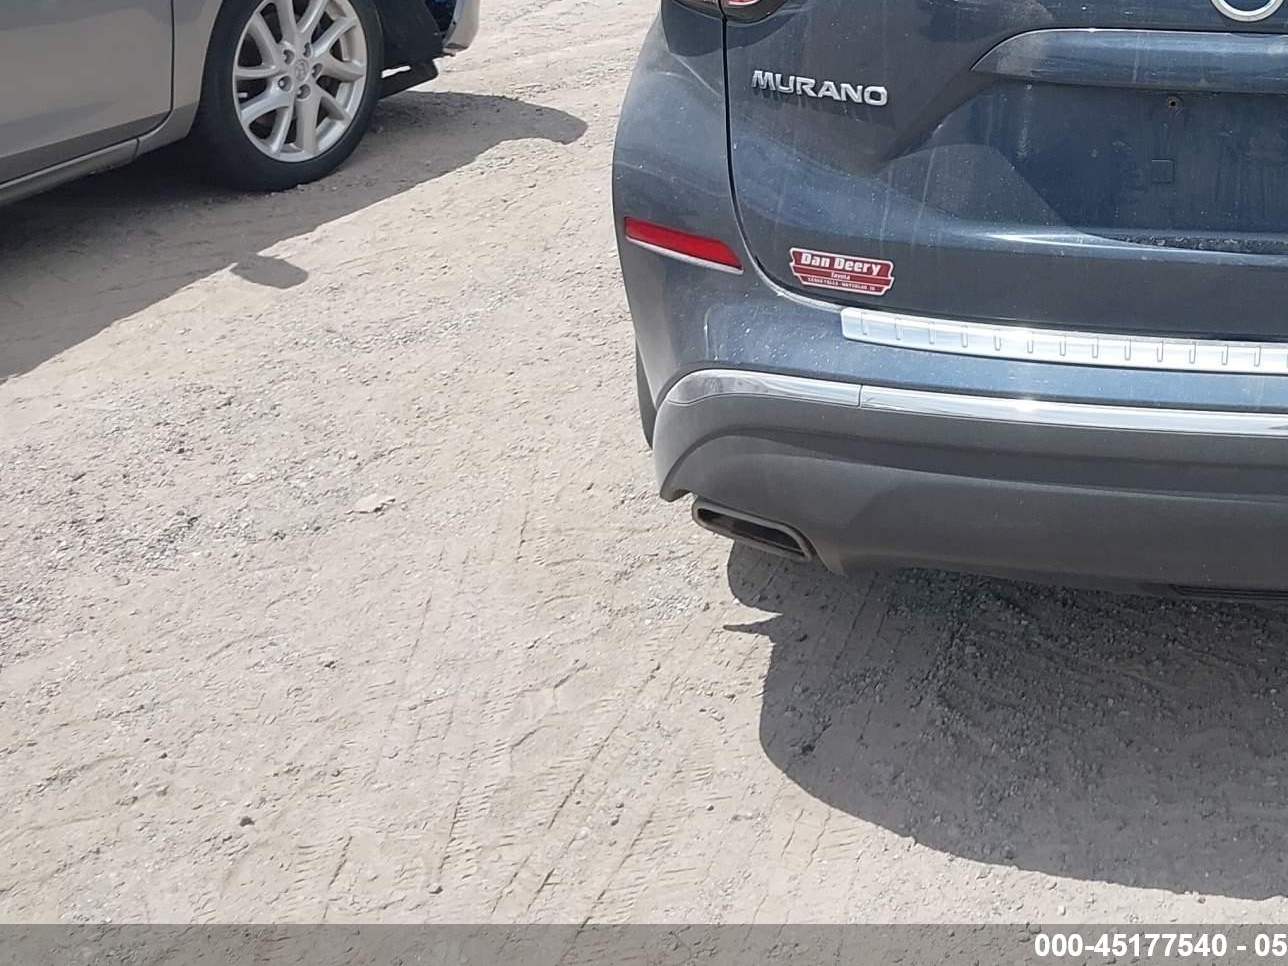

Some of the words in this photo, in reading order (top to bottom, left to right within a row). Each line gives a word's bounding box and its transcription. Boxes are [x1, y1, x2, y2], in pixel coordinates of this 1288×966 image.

[752, 70, 888, 107] MURANO
[801, 252, 831, 268] Dan
[833, 257, 882, 276] Deery
